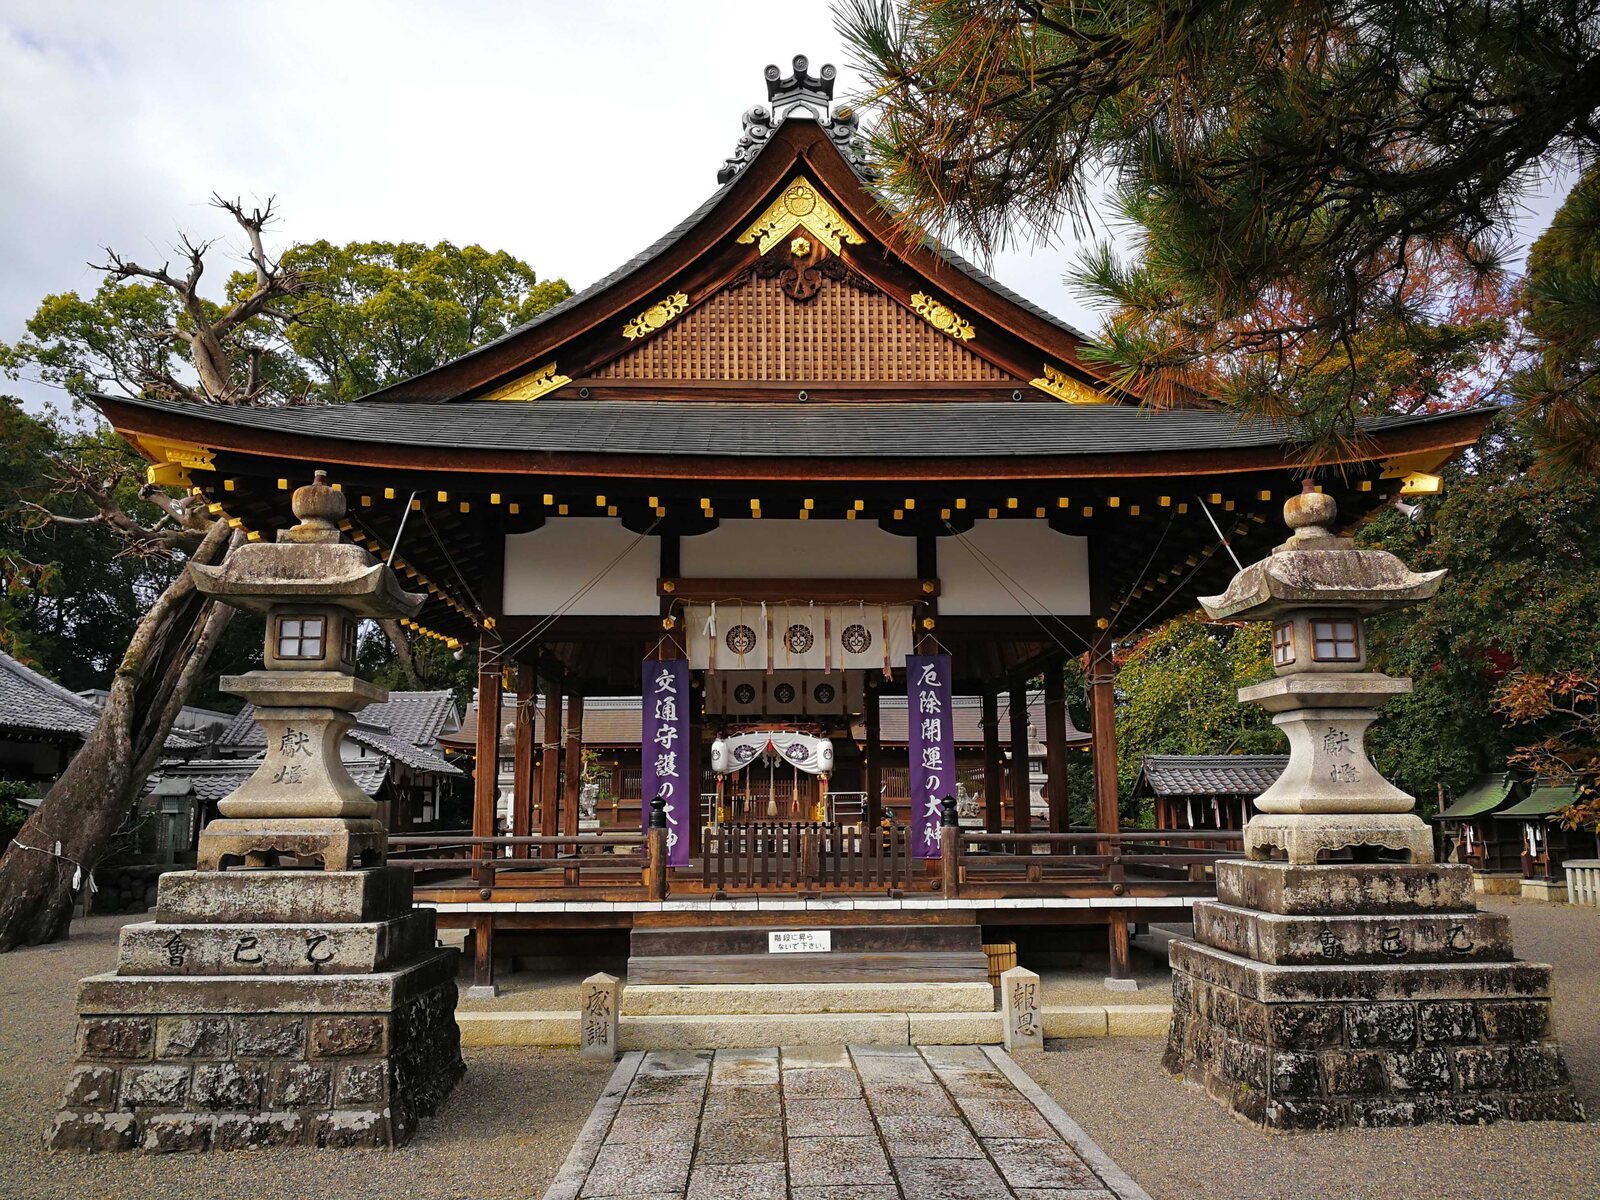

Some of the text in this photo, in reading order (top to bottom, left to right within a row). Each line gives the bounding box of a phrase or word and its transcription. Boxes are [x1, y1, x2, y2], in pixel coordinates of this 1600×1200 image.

[774, 933, 813, 942] 階段に昇ら
[778, 942, 826, 950] ないで下さい。
[585, 986, 610, 1046] 感謝
[1013, 982, 1038, 1036] 報恩
